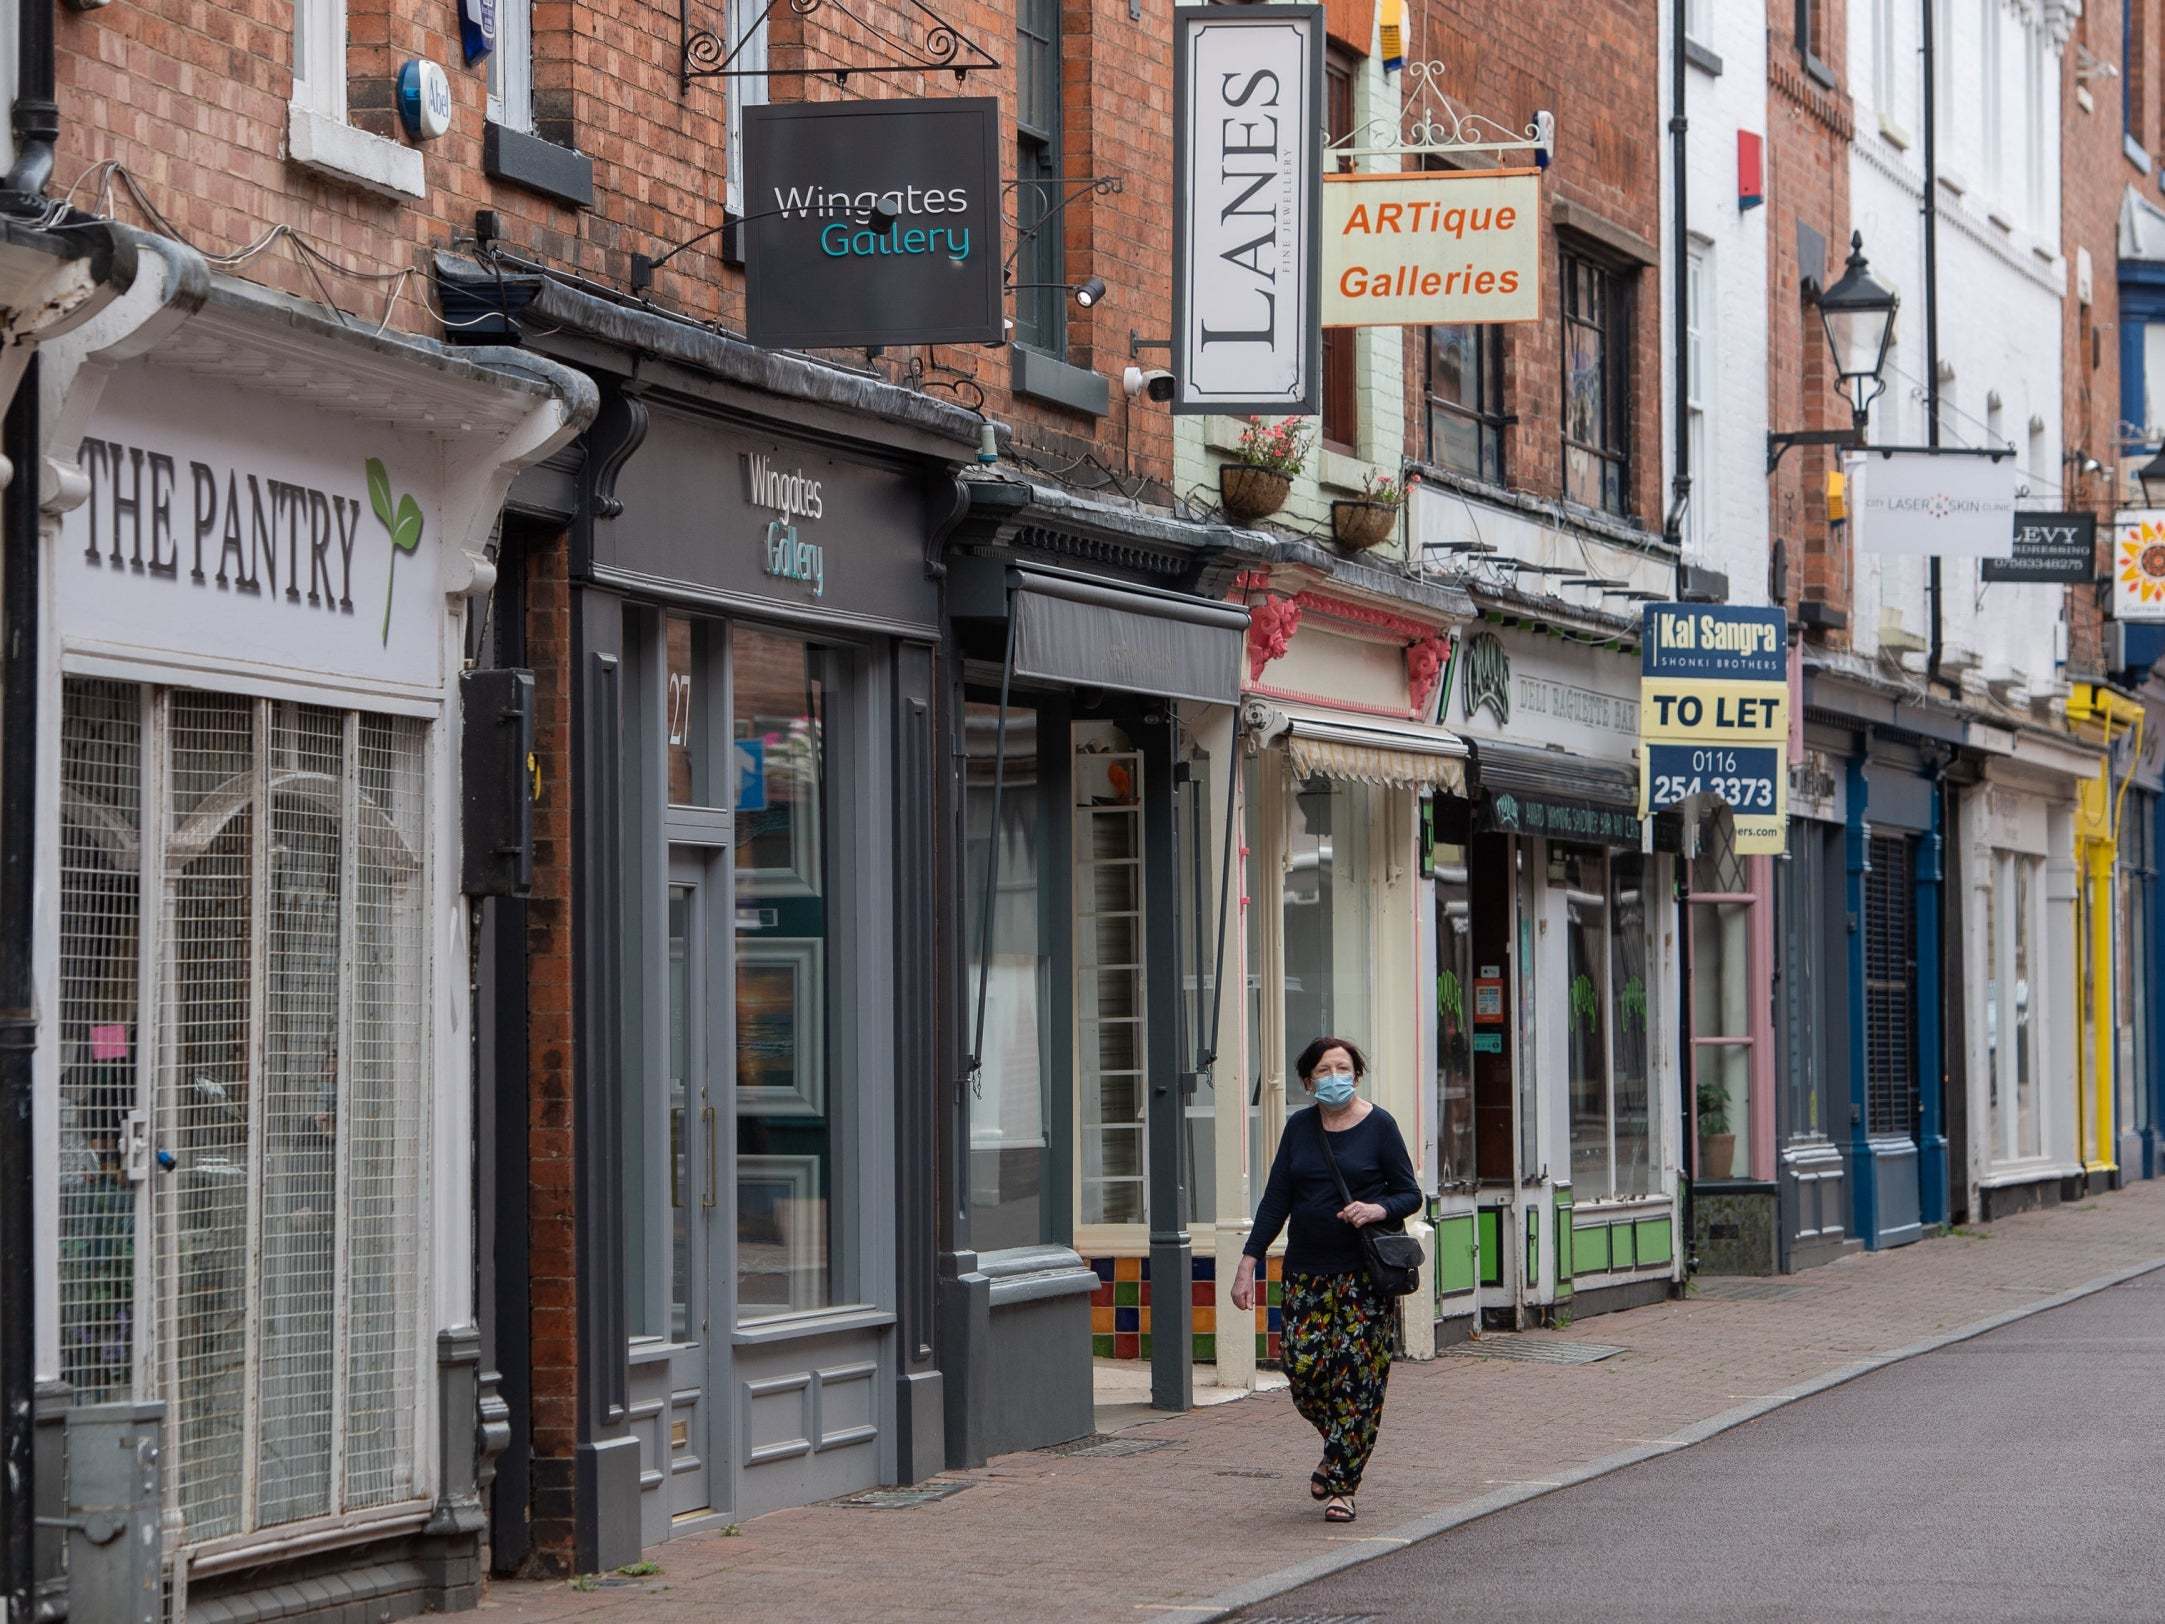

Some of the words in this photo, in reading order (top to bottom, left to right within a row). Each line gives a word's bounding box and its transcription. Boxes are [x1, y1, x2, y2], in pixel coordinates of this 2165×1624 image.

[429, 77, 449, 118] Abel
[774, 185, 967, 224] Wingates
[1282, 149, 1292, 233] JEWELLERY
[1201, 69, 1279, 353] LANES
[1342, 202, 1516, 239] ARTique
[820, 222, 969, 260] Gallery
[1282, 241, 1291, 273] FINE
[1339, 264, 1519, 298] Galleries
[750, 452, 822, 525] Wingates
[1888, 499, 1930, 511] LASER
[1949, 500, 1979, 512] SKIN
[77, 436, 177, 573] THE
[190, 460, 360, 608] PANTRY
[768, 522, 823, 597] Gallery
[2013, 545, 2090, 555] RDRESSING
[1661, 613, 1696, 649] Kal
[1701, 615, 1776, 656] Sangra
[1661, 657, 1709, 667] SHONKI
[1717, 658, 1777, 670] BROTHERS
[669, 672, 690, 747] 27
[1519, 680, 1546, 713] DELI
[1614, 700, 1636, 732] BAR
[1653, 695, 1703, 726] TO
[1716, 697, 1780, 728] LET
[1692, 750, 1736, 773] 0116
[1710, 777, 1772, 807] 3373
[1737, 827, 1777, 837] ers.com
